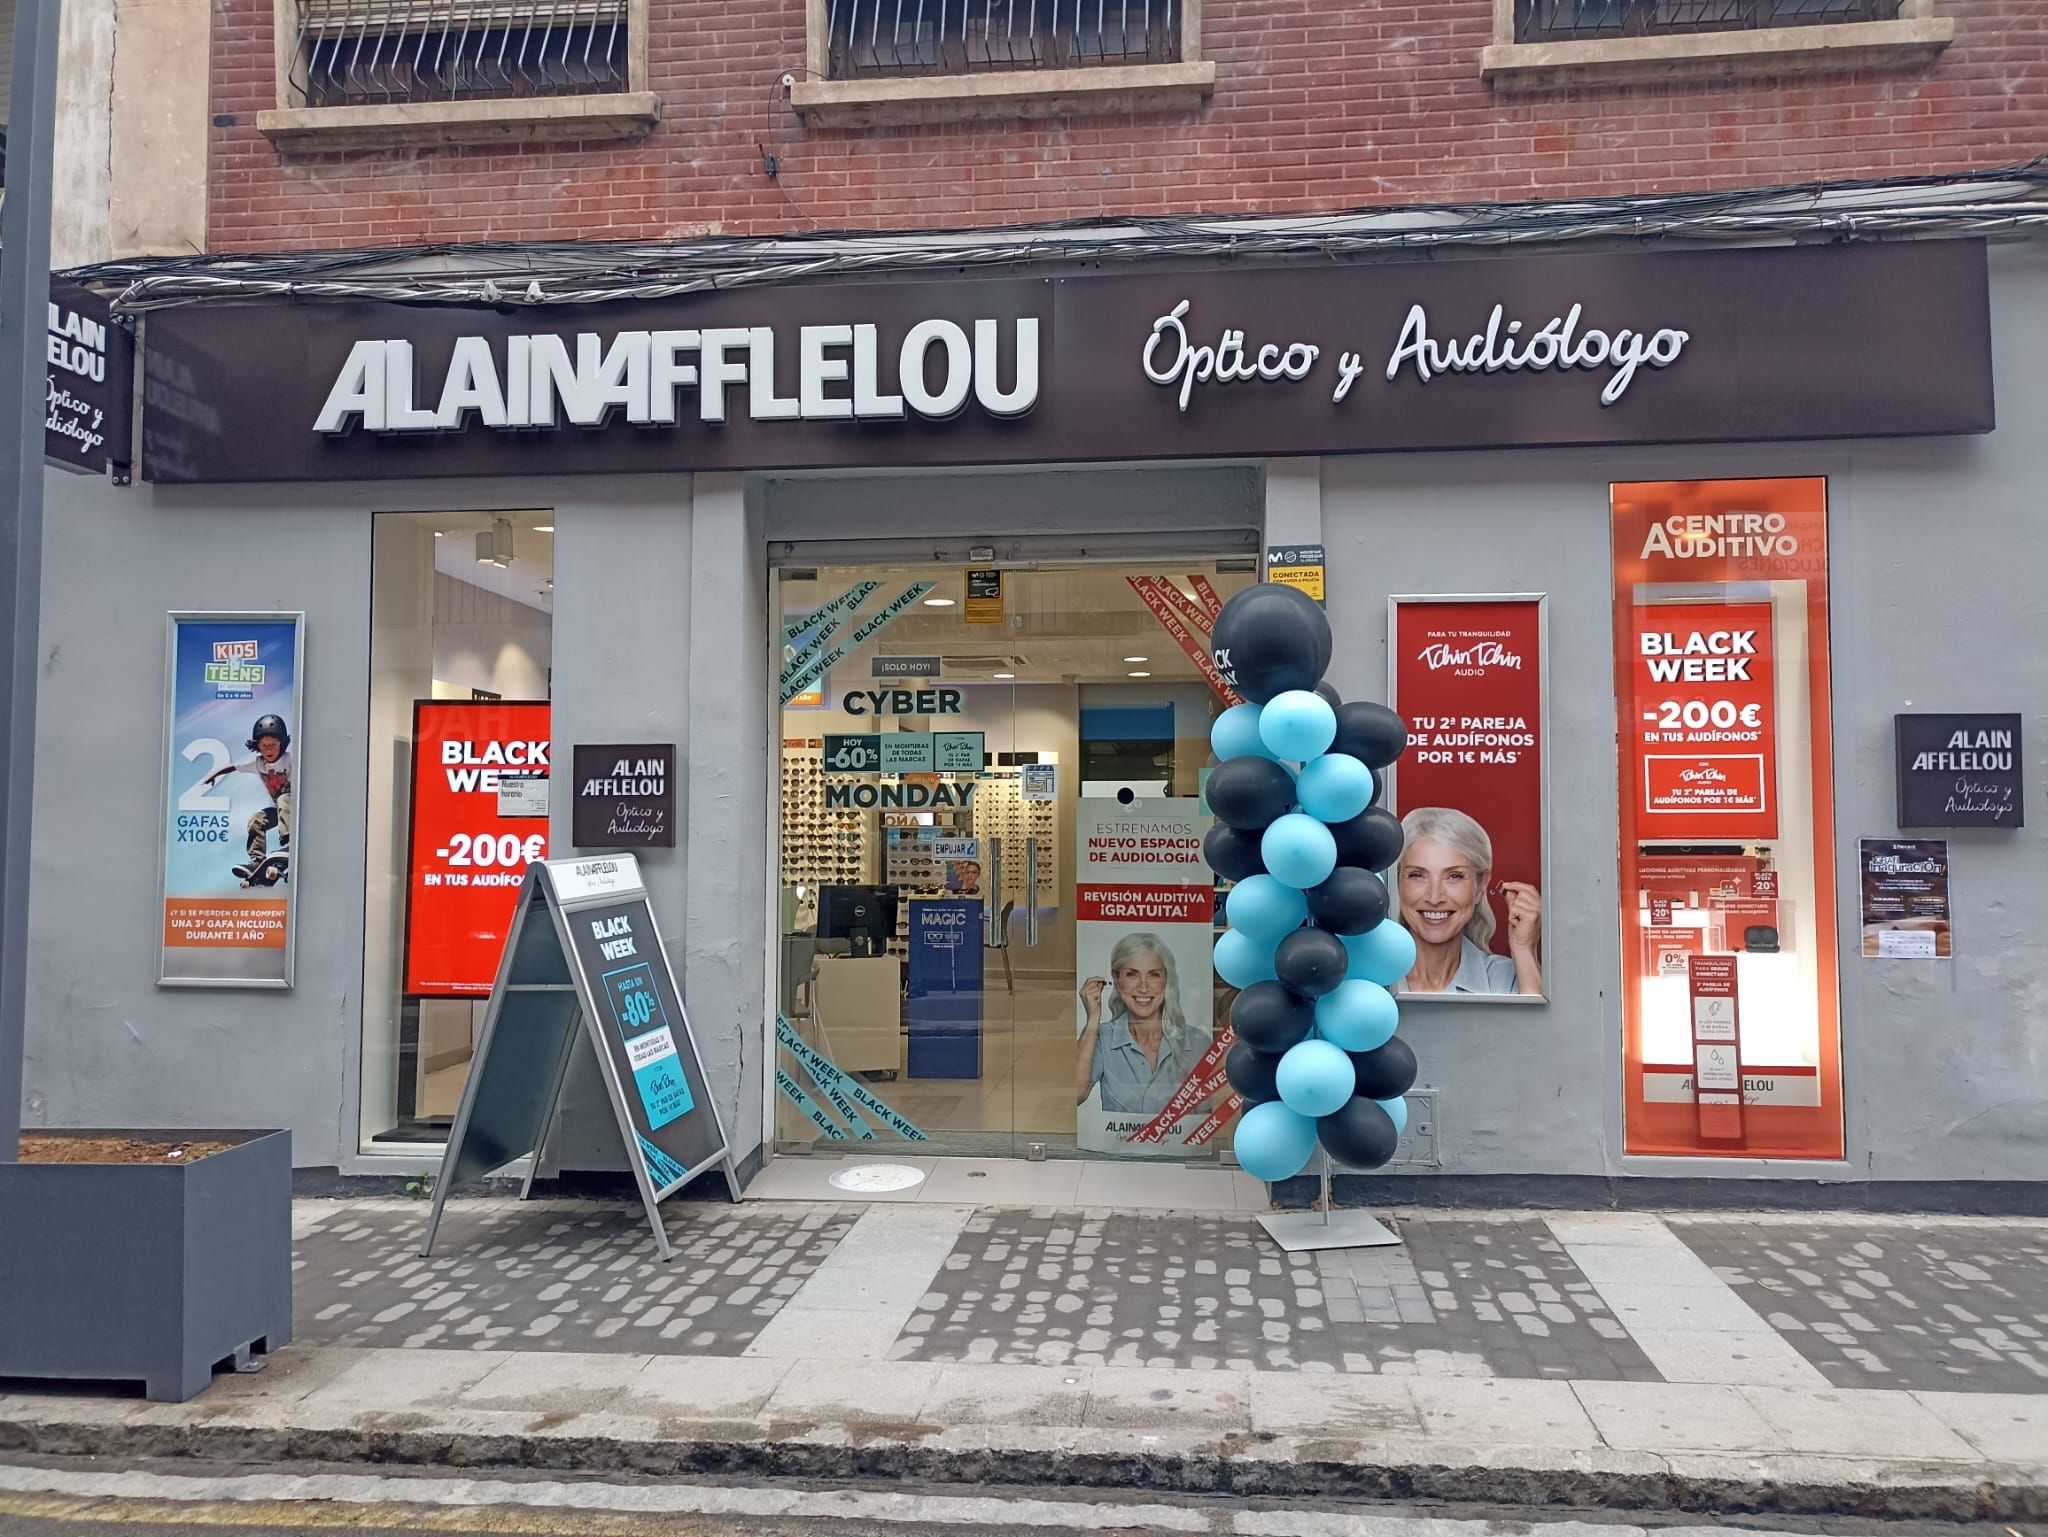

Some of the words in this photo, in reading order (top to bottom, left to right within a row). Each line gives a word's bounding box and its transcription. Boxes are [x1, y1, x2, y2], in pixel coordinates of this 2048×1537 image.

[48, 302, 106, 352] LAIN
[48, 334, 106, 383] ELOU
[1143, 299, 1320, 412] Óptico
[1332, 349, 1363, 403] y
[1386, 303, 1690, 406] Audiólogo
[92, 407, 104, 429] y
[1666, 513, 1785, 536] CENTRO
[1640, 522, 1798, 560] AUDITIVO
[1272, 571, 1320, 579] CONECTADA
[846, 581, 878, 611] BLAC
[1150, 576, 1185, 611] BLACK
[1198, 582, 1223, 617] BLAC
[788, 609, 827, 639] BLACK
[853, 610, 891, 643] BLACK
[889, 583, 924, 613] WEEK
[1158, 605, 1188, 642] WEEK
[216, 642, 254, 659] KIDS
[780, 648, 812, 685] BLACK
[810, 617, 841, 649] WEEK
[1640, 630, 1757, 656] BLACK
[811, 647, 845, 676] WEEK
[1417, 643, 1472, 671] Tchin
[1469, 641, 1522, 670] Tchin
[208, 665, 261, 682] TEENS
[881, 663, 907, 673] ¡SOLO
[909, 663, 931, 671] HOY!
[1454, 668, 1485, 677] AUDIO
[1646, 657, 1752, 682] WEEK
[842, 689, 962, 716] CYBER
[1412, 717, 1435, 730] TU
[1461, 717, 1527, 730] PAREJA
[1643, 700, 1762, 729] -200€
[843, 738, 863, 747] HOY
[1406, 733, 1429, 746] DE
[1433, 731, 1534, 747] AUDÍFONOS
[1644, 732, 1659, 742] EN
[1662, 732, 1684, 742] TUS
[1947, 730, 2012, 749] ALAIN
[441, 740, 550, 766] BLACK
[827, 747, 879, 769] -60%
[1417, 751, 1453, 764] POR
[1457, 751, 1476, 764] 1€
[1911, 751, 2013, 771] AFFLELOU
[178, 738, 232, 811] 2
[611, 759, 665, 777] ALAIN
[581, 778, 665, 797] AFFLELOU
[825, 781, 977, 809] MONDAY
[1955, 776, 1999, 800] Óptico
[2003, 787, 2012, 801] y
[1653, 796, 1702, 804] AUDÍFONOS
[177, 815, 230, 828] GAFAS
[656, 809, 664, 823] y
[177, 829, 230, 843] X100€
[1096, 823, 1193, 835] ESTRENAMOS
[436, 833, 546, 867] -200€
[935, 843, 967, 854] EMPUJAR
[1088, 837, 1137, 849] NUEVO
[1140, 838, 1201, 849] ESPACIO
[1089, 852, 1107, 863] DE
[1110, 849, 1200, 864] AUDIOLOGÍA
[424, 874, 443, 886] EN
[445, 874, 469, 887] TUS
[471, 871, 525, 887] AUDÍFO
[1084, 890, 1142, 903] REVISIÓN
[1145, 892, 1206, 903] AUDITIVA
[921, 912, 967, 926] MAGIC
[1100, 904, 1188, 917] ¡GRATUITA!
[171, 920, 193, 928] UNA
[207, 920, 234, 929] GAFA
[236, 920, 283, 929] INCLUIDA
[186, 931, 233, 940] DURANTE
[236, 931, 240, 940] 1
[591, 915, 633, 940] BLACK
[600, 937, 638, 961] WEEK
[1665, 953, 1685, 963] 0%
[809, 1054, 845, 1084] WEEK
[853, 1087, 892, 1121] BLACK
[1171, 1074, 1203, 1111] WEEK
[777, 1071, 806, 1105] WEEK
[812, 1110, 844, 1140] BLAC
[828, 1087, 859, 1123] WEEK
[1187, 1115, 1222, 1146] WEEK
